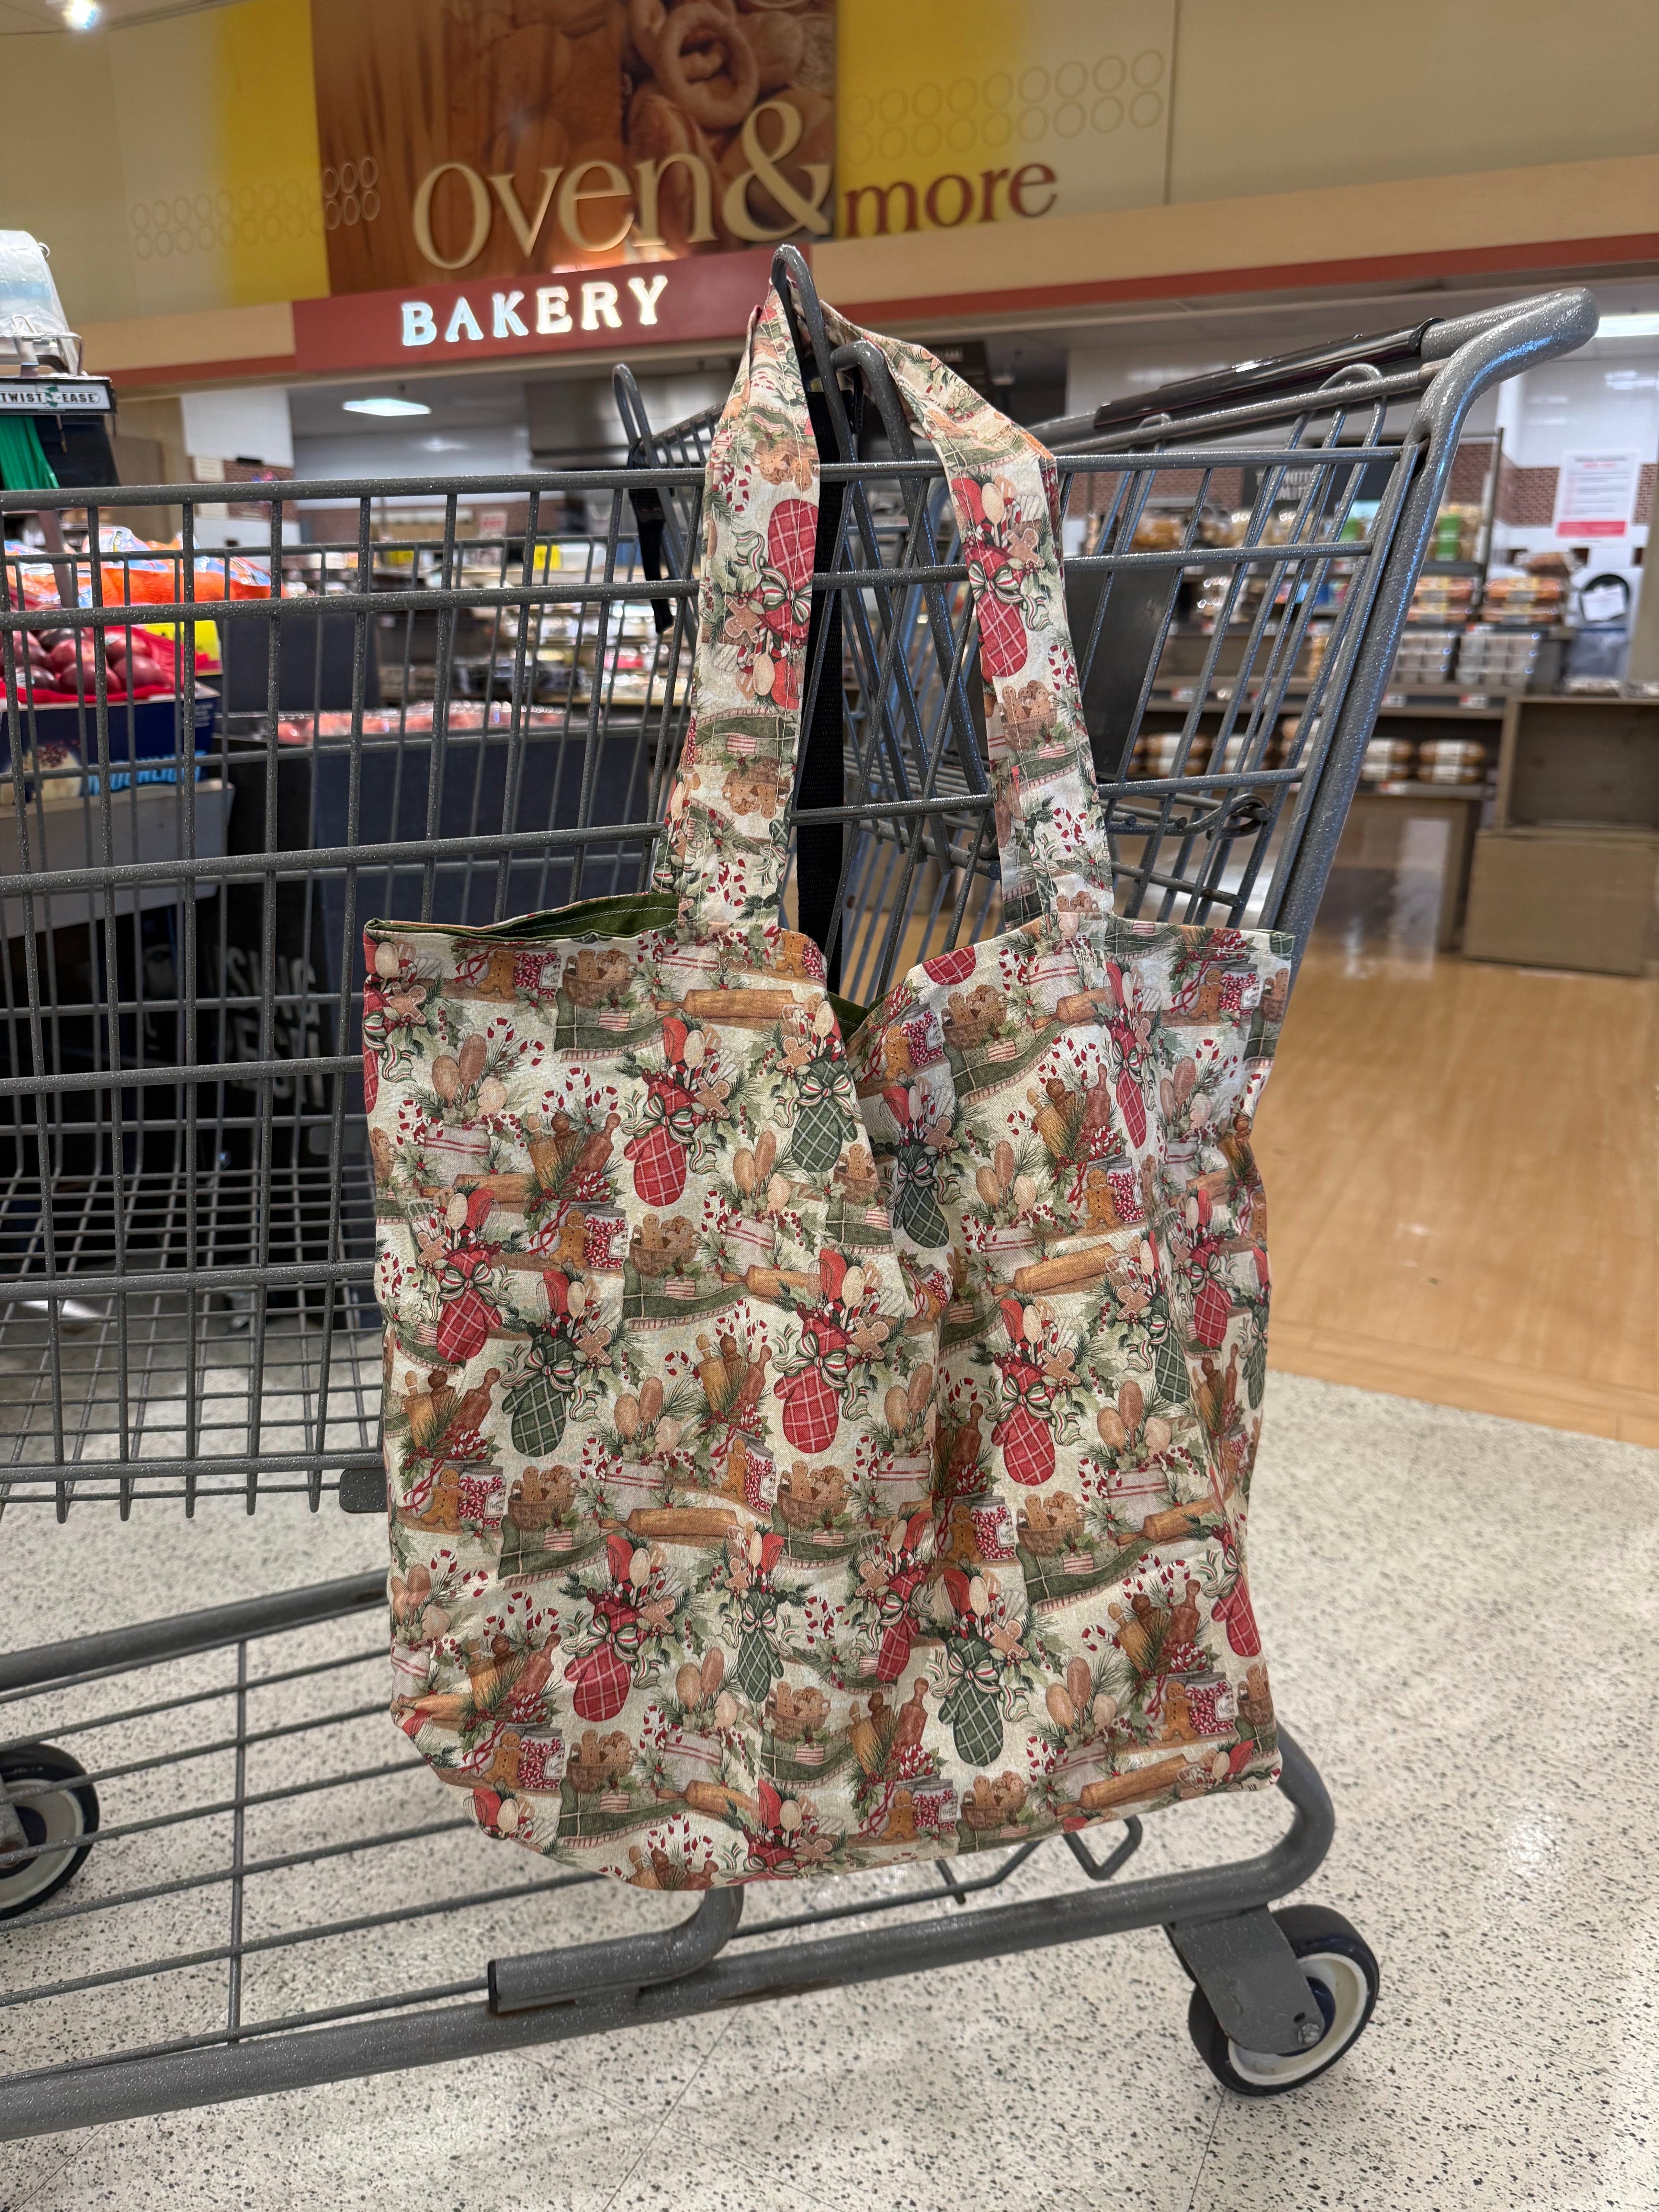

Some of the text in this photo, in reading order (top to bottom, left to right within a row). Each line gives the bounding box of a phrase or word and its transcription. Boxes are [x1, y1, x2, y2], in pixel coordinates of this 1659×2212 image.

[722, 100, 832, 242] &
[844, 162, 1058, 238] more
[401, 274, 668, 346] BAKERY
[0, 394, 42, 403] TWIST
